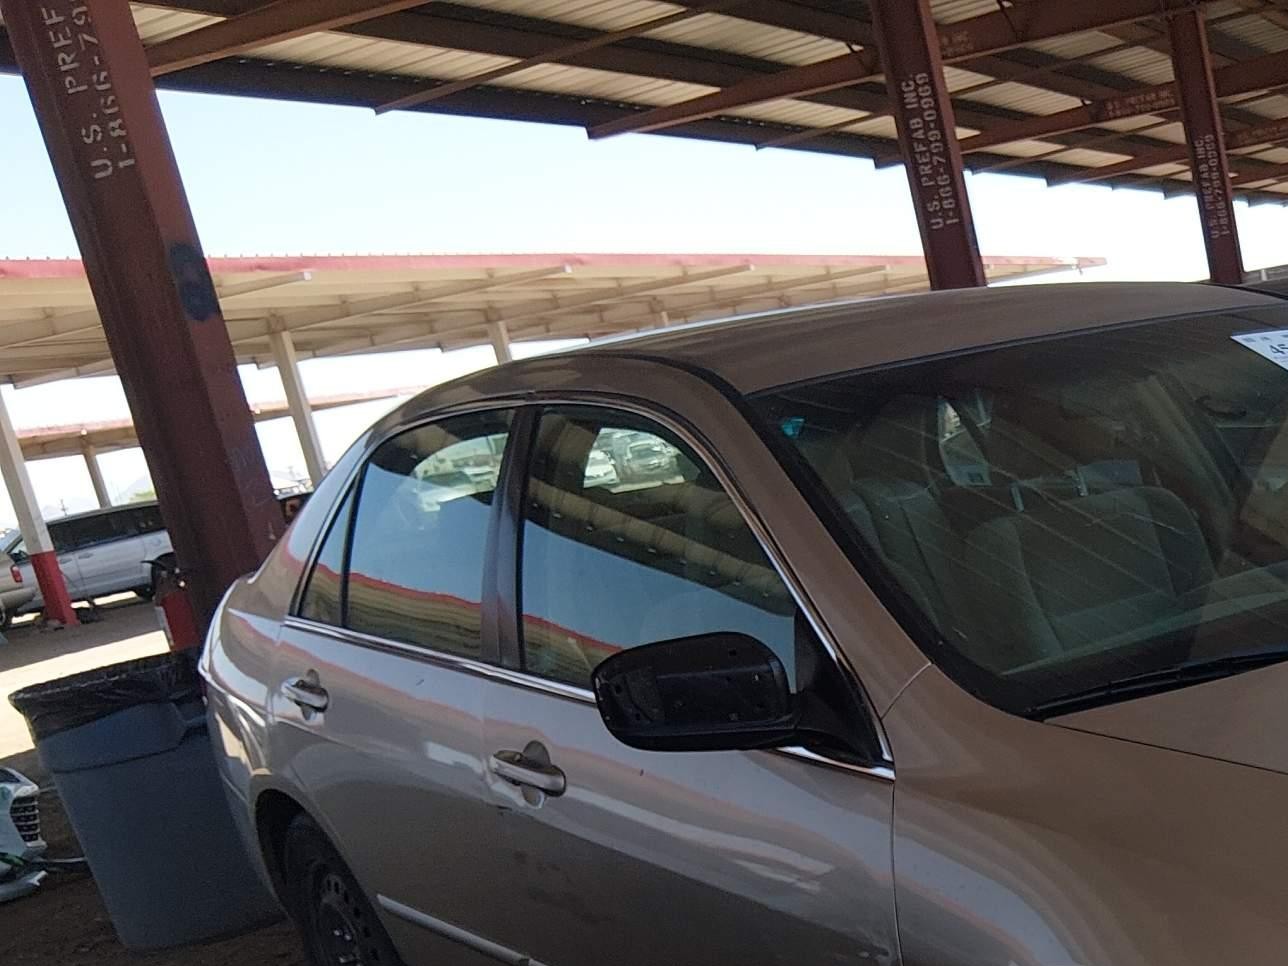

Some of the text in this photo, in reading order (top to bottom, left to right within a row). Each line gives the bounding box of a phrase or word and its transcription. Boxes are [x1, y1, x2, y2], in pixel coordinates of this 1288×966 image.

[71, 0, 135, 168] 1-866-79
[81, 112, 113, 179] U.S.
[902, 74, 944, 229] U.S. PREFAB INC.
